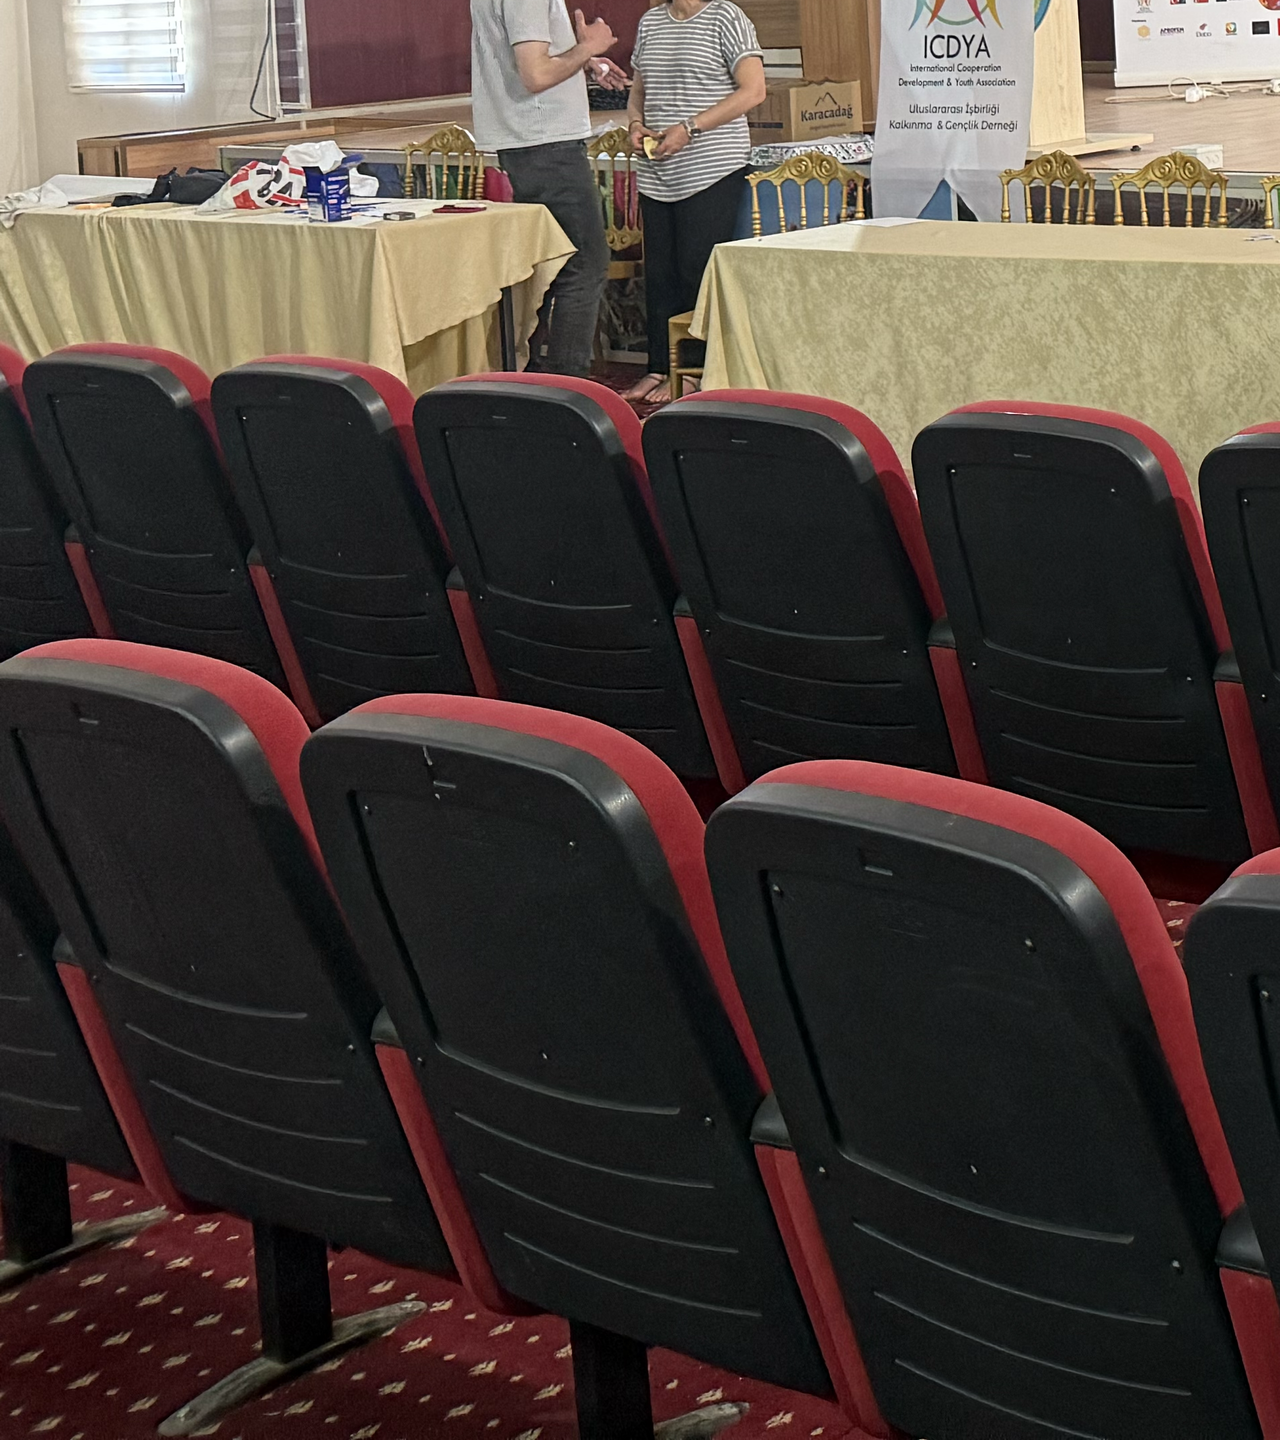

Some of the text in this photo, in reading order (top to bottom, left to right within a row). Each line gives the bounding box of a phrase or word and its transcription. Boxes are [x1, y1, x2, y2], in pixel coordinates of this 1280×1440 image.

[924, 34, 991, 59] ICDYA
[910, 63, 1001, 74] International Cooperation
[898, 77, 1016, 88] Development & Youth Association
[801, 103, 853, 122] Karacadağ
[909, 102, 1000, 116] Uluslararası İşbirliği
[889, 120, 1018, 132] Kalkınma & Gençlik Derneği
